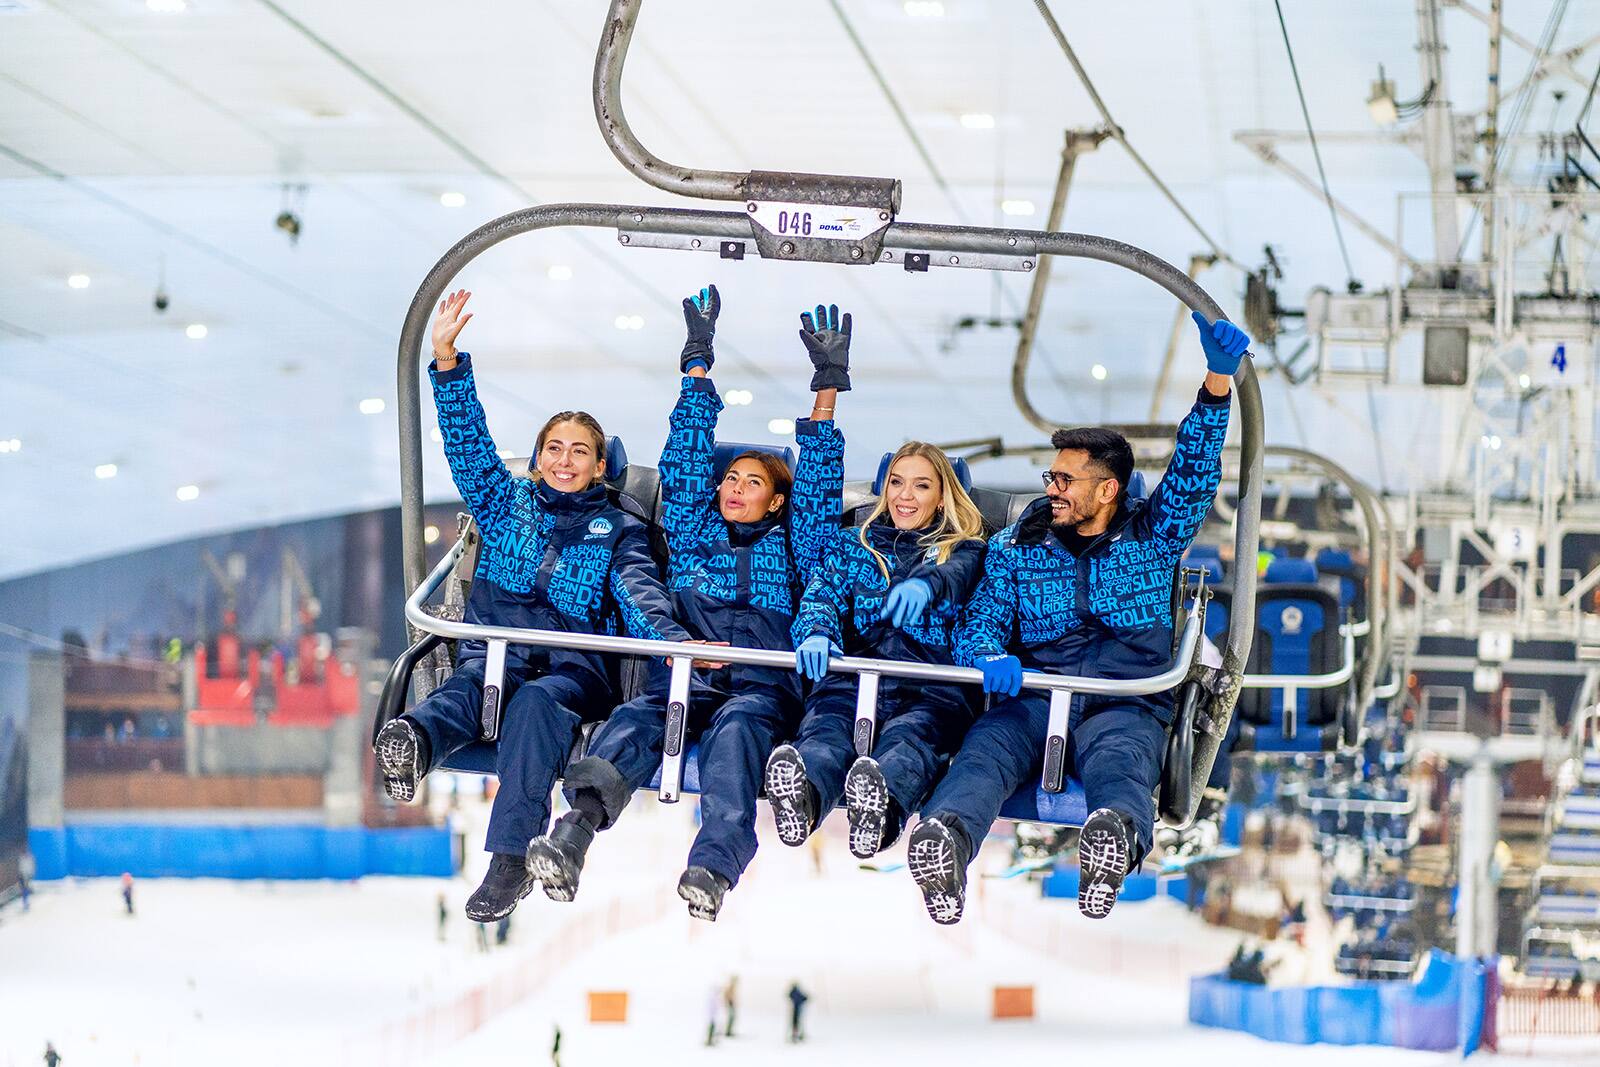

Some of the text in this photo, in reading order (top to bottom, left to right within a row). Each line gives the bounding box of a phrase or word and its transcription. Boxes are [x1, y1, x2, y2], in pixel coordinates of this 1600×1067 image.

[778, 211, 812, 235] 046
[1551, 345, 1567, 373] 4
[1003, 547, 1047, 562] ENJOY
[1028, 558, 1061, 570] ENJOY
[757, 572, 787, 582] ENJOY
[1033, 572, 1052, 580] RIDE
[1100, 568, 1127, 582] ROLL
[549, 578, 579, 594] SPIN
[758, 584, 777, 593] RIDE
[1116, 582, 1132, 596] SKI
[1135, 592, 1158, 607] RIDE
[558, 601, 588, 615] ENJOY
[1043, 600, 1069, 615] RIDE
[1110, 606, 1156, 627] ROLL
